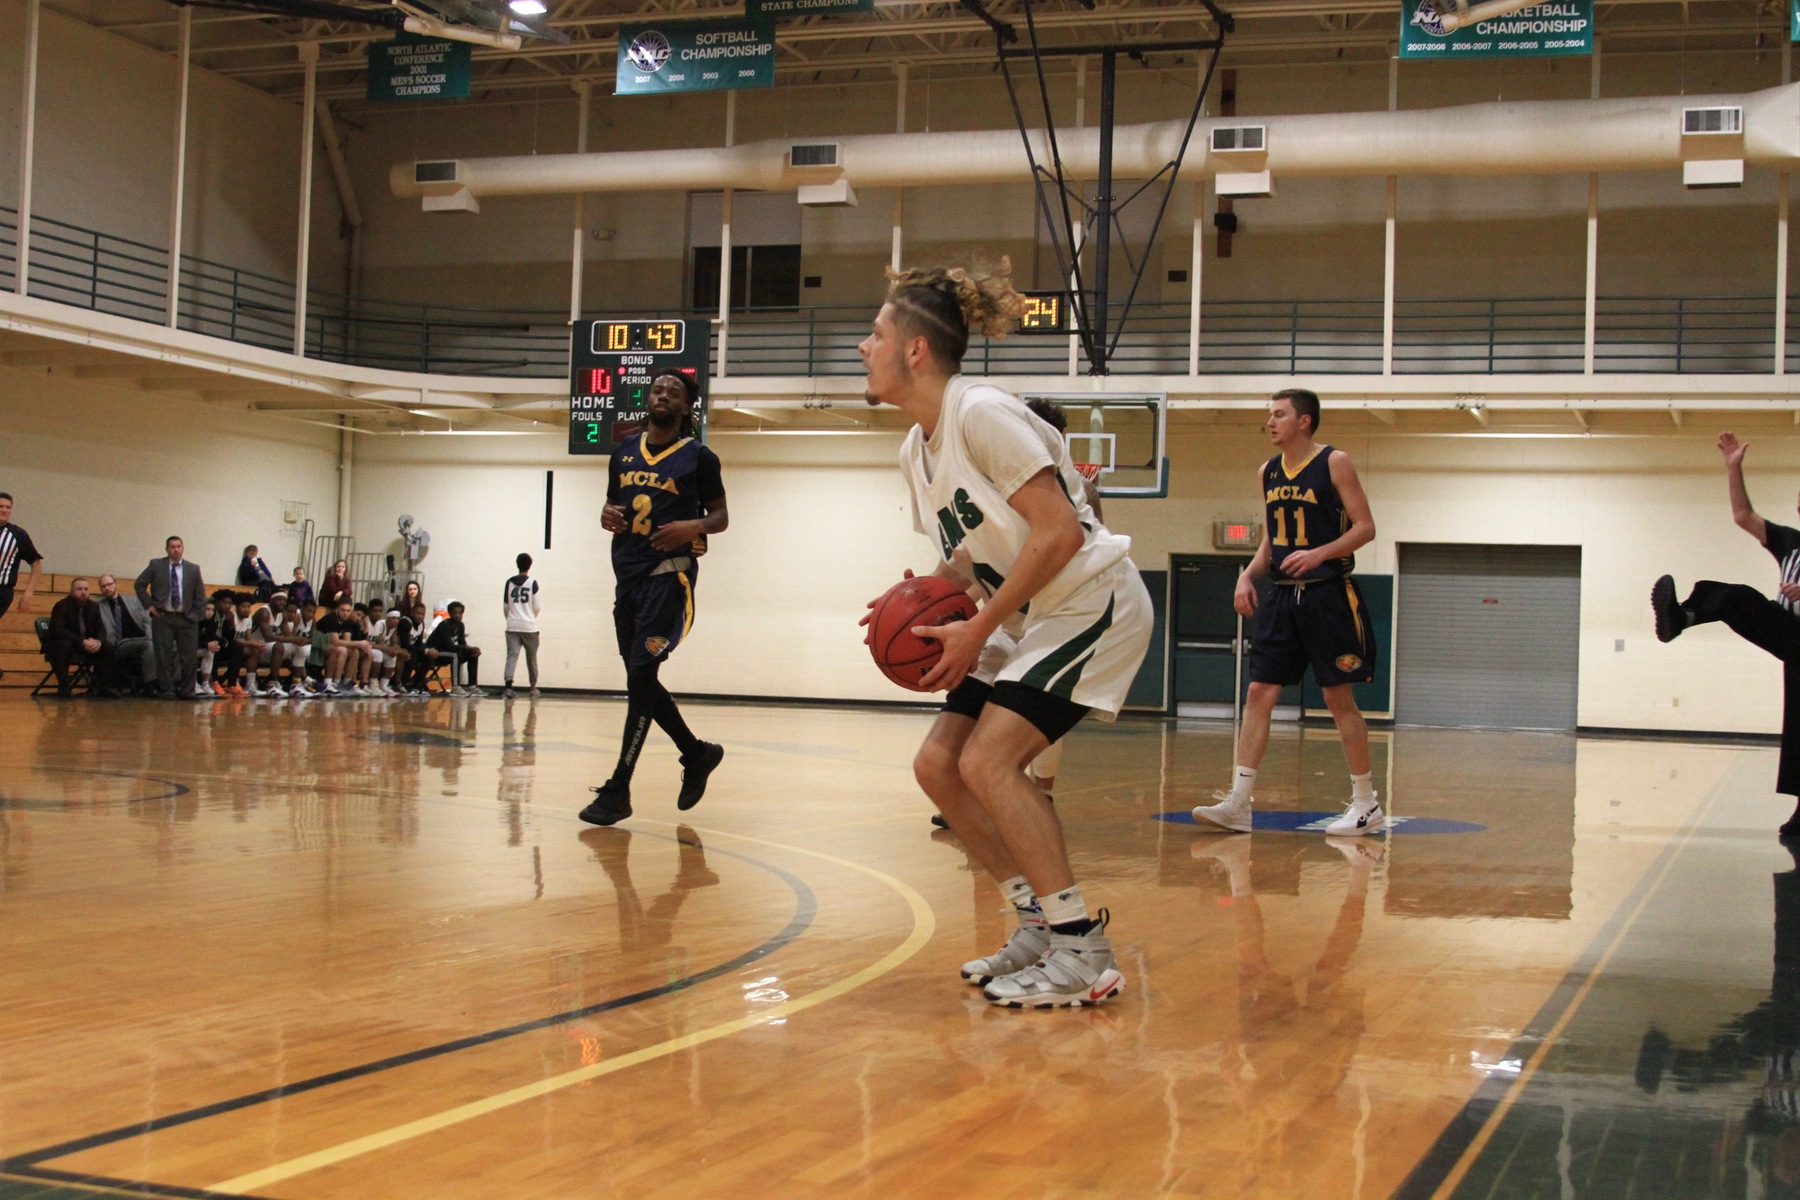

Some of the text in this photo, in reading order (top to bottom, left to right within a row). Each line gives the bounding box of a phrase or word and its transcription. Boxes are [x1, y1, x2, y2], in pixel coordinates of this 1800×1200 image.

[761, 0, 858, 11] STATE CHAMPIONS
[1496, 4, 1580, 18] SKETBALL
[1476, 19, 1587, 35] CHAMPIONSHIP
[696, 31, 758, 45] SOFTBALL
[387, 43, 452, 55] NORTH ATLANTIC
[681, 44, 772, 60] CHAMPIONSHIP
[1407, 43, 1446, 51] 2007-2008
[1452, 42, 1492, 51] 2006-2007
[1544, 40, 1585, 48] 2005-2004
[394, 54, 444, 65] CONFERENCE
[410, 65, 427, 74] 2001
[391, 74, 446, 86] MEN'S SOCCER
[396, 85, 441, 95] CHAMPIONS
[1024, 298, 1057, 326] 24
[621, 356, 654, 365] BONUS
[628, 367, 646, 375] POSS
[591, 369, 611, 394] 10
[621, 376, 652, 385] PERIOD
[571, 396, 615, 409] HOME
[572, 411, 603, 421] FOULS
[617, 411, 650, 421] PLAYE
[587, 423, 598, 443] 2
[619, 471, 679, 495] MCLA
[1266, 485, 1318, 505] MCLA
[632, 494, 653, 536] 2
[1272, 506, 1310, 547] 11
[510, 587, 530, 604] 45
[625, 715, 646, 766] ARMOUR
